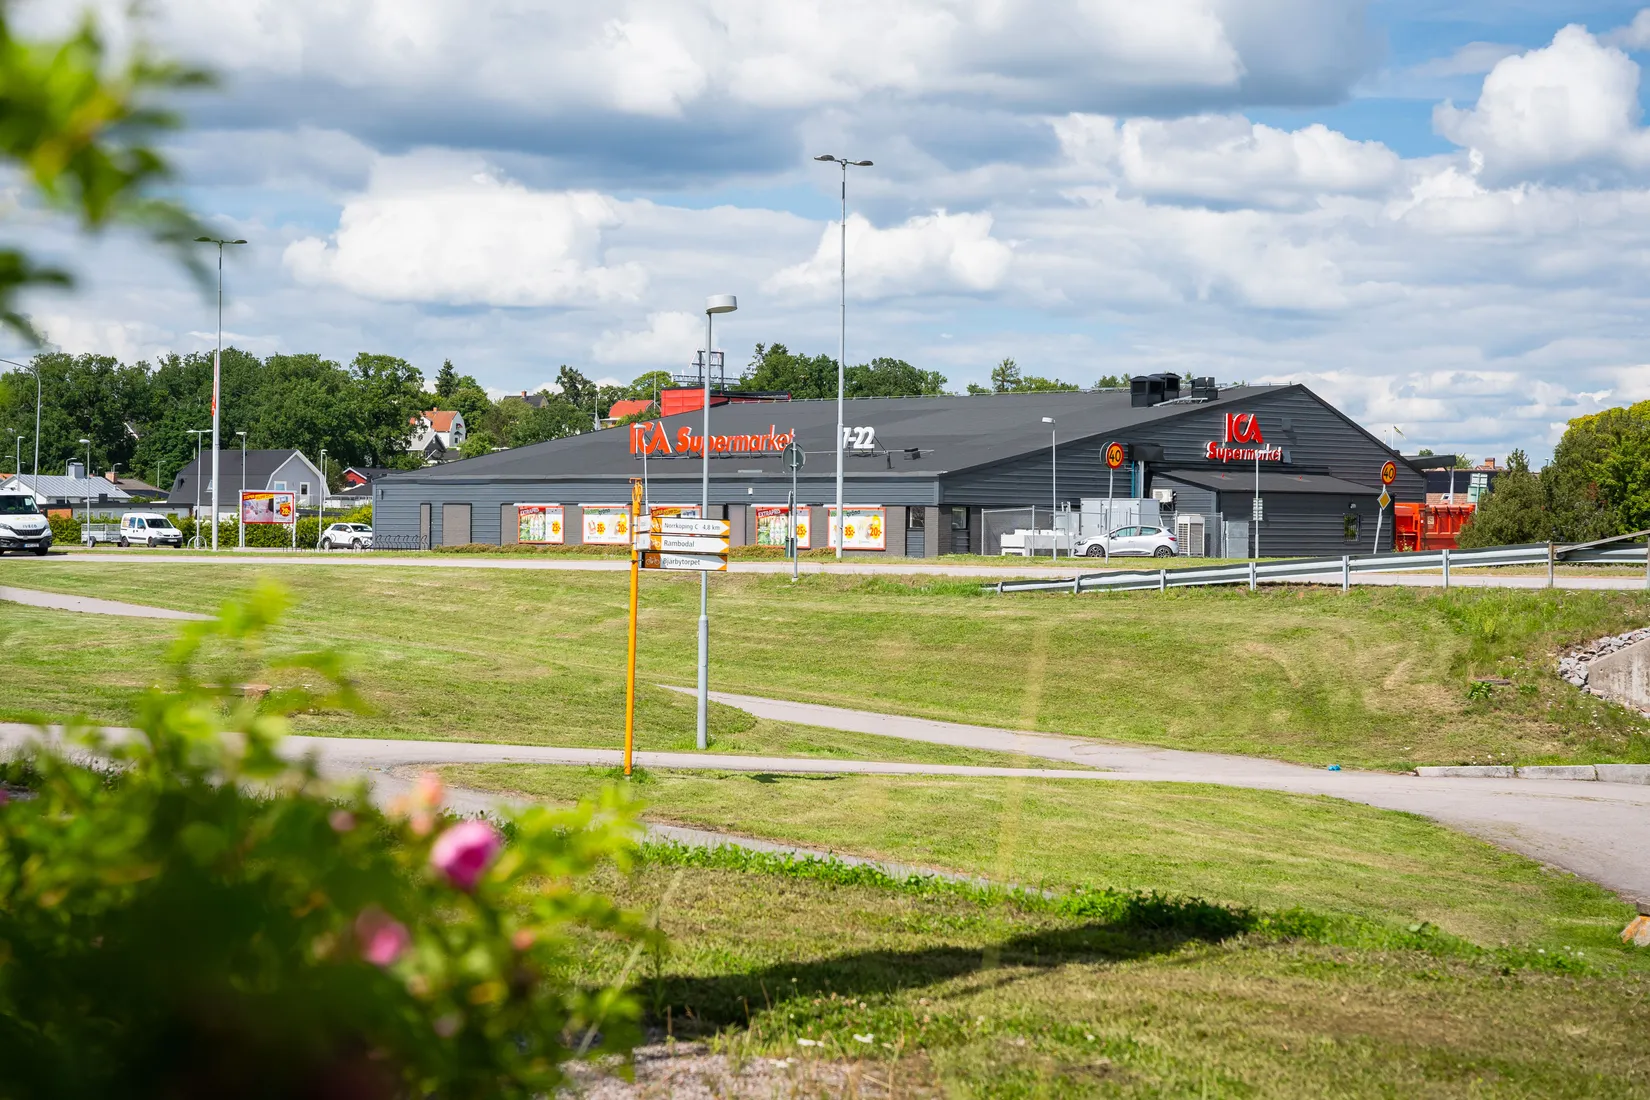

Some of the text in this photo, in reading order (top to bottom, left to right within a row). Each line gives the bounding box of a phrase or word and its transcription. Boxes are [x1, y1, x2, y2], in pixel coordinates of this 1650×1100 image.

[1225, 413, 1264, 444] ICA
[629, 421, 795, 458] ICA Supermarket
[1109, 449, 1121, 462] 40
[1206, 441, 1283, 463] Supermarket
[1384, 467, 1394, 480] 40
[663, 539, 695, 547] Rambodal
